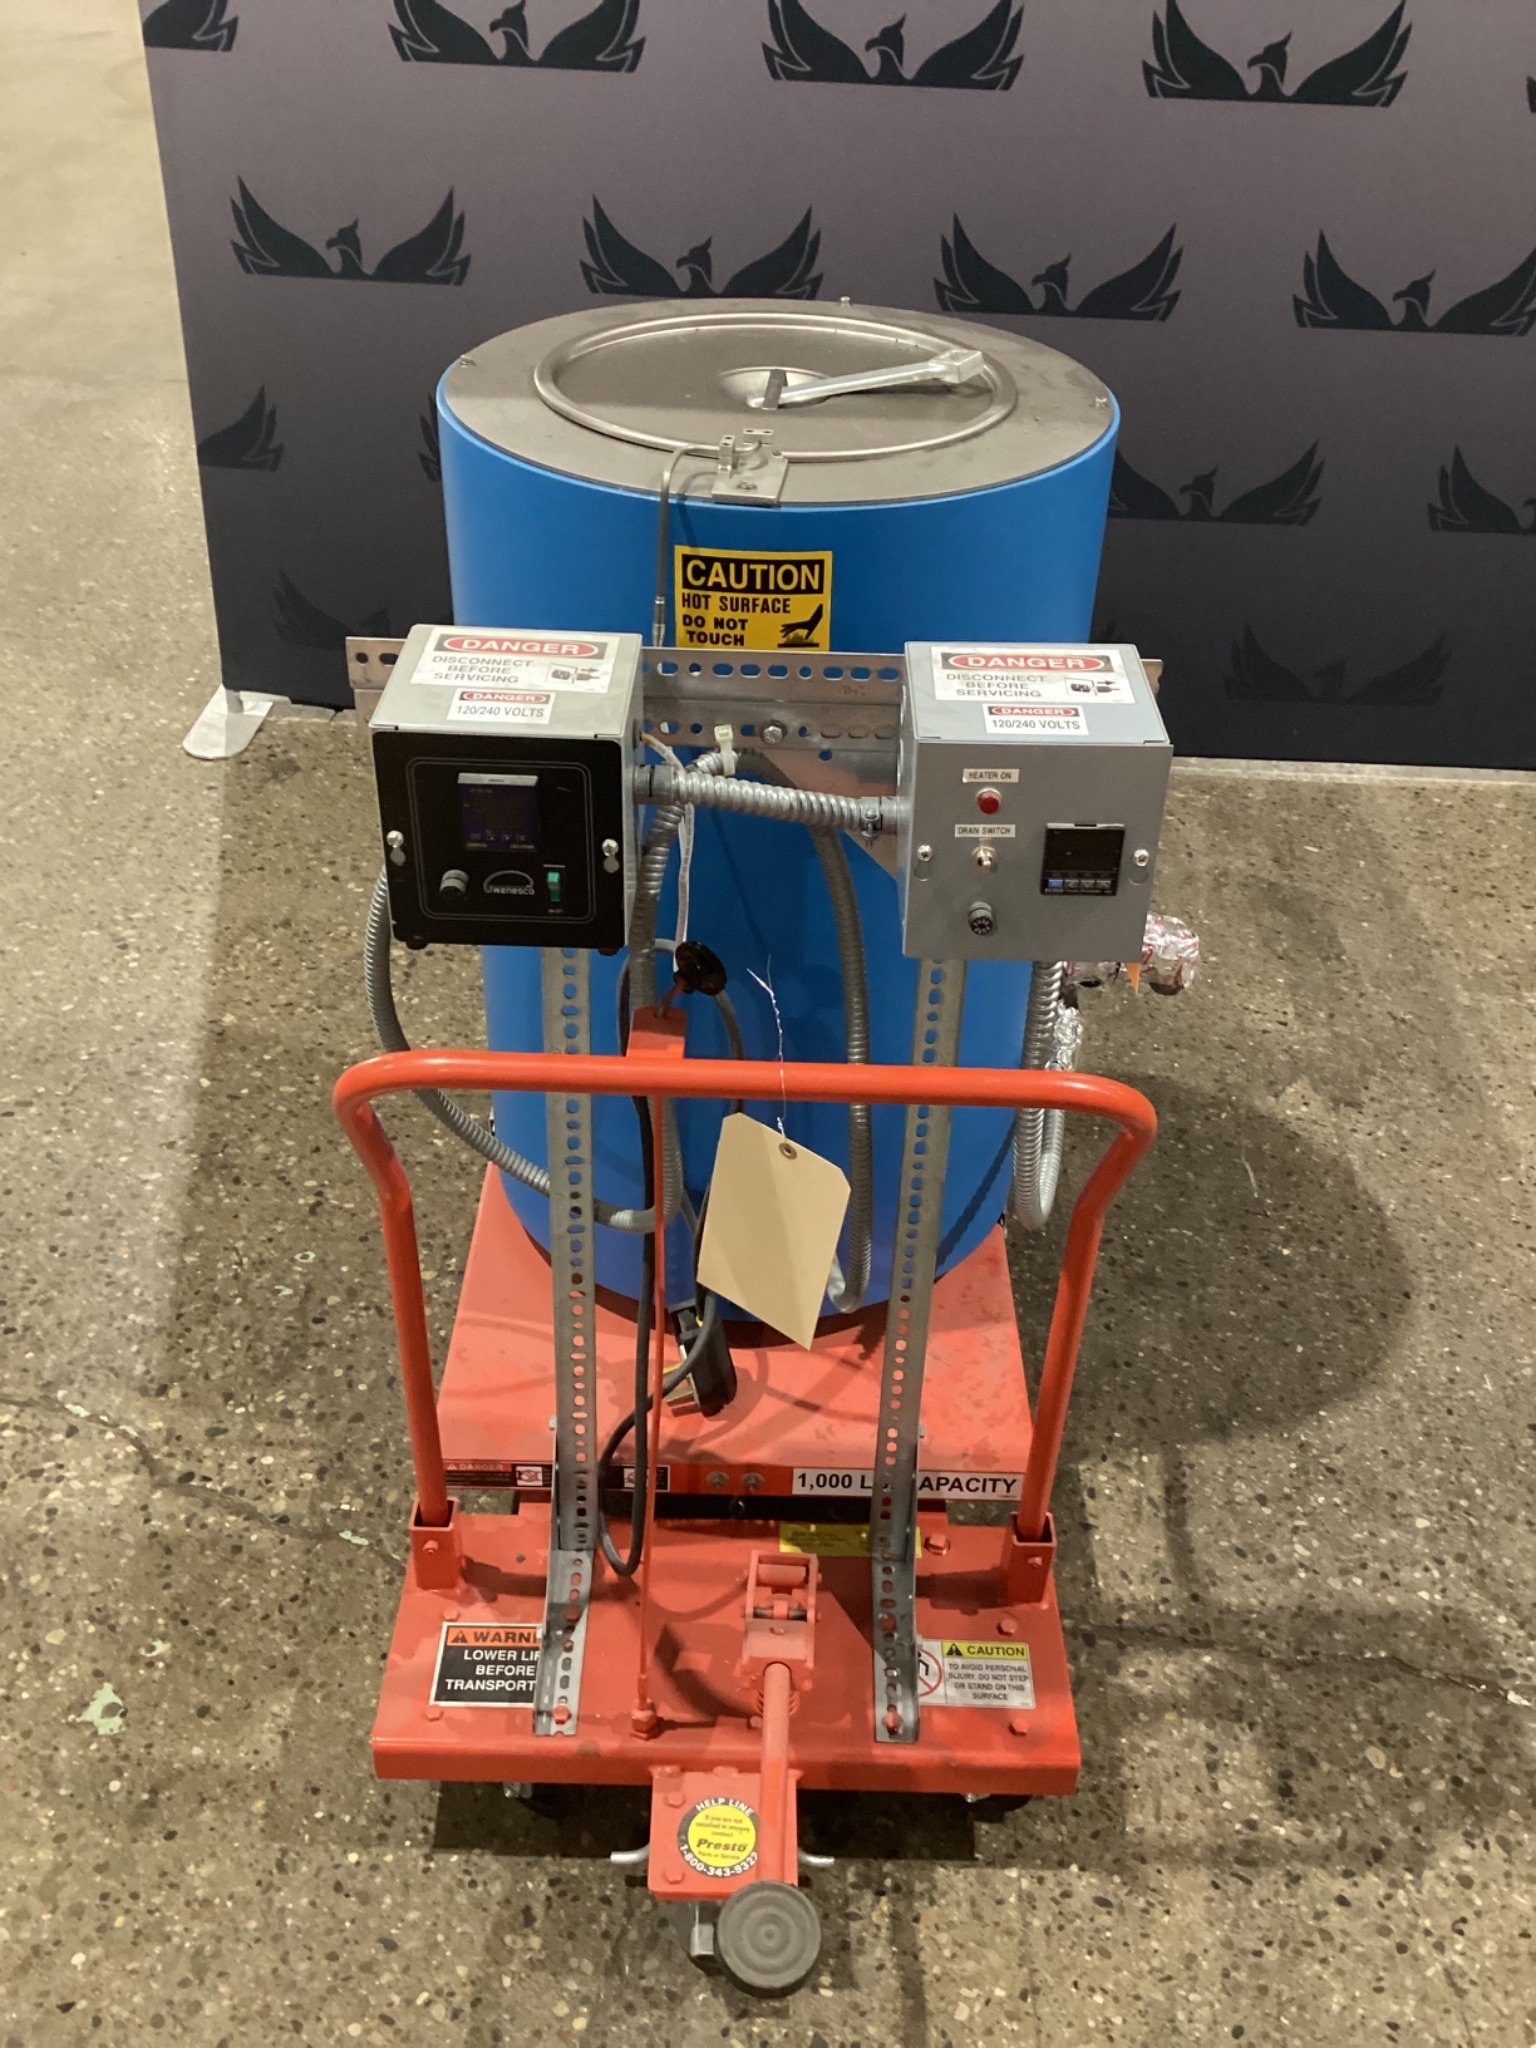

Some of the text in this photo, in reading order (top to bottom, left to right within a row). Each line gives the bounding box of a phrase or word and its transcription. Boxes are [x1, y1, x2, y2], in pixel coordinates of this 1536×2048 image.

[686, 559, 820, 591] CAUTION
[682, 593, 791, 614] HOT SURFACE
[682, 614, 748, 631] DO NOT
[686, 631, 745, 646] TOUCH
[461, 639, 580, 655] DANGER
[432, 656, 533, 667] DISCONNECT
[967, 656, 1086, 669] DANGER
[447, 665, 511, 675] BEFORE
[433, 672, 519, 684] SERVICING
[946, 673, 1046, 682] DISCONNECT
[965, 681, 1030, 690] BEFORE
[472, 693, 542, 702] DANGER
[956, 689, 1042, 698] SERVICING
[457, 705, 545, 718] 120/240 VOLTS
[1001, 707, 1065, 715] DANGER
[992, 719, 1081, 730] 120/240 VOLTS
[968, 771, 1012, 780] HEATER ON
[958, 827, 1011, 835] DRAIN SWITCH
[459, 1463, 504, 1472] DANGER
[797, 1472, 853, 1490] 1,000
[918, 1476, 1018, 1493] APACITY
[473, 1631, 537, 1644] WARNI
[463, 1650, 541, 1661] LOWER LIF
[966, 1645, 1025, 1657] CAUTION
[475, 1665, 535, 1676] BEFORE
[961, 1663, 983, 1671] AVOID
[985, 1664, 1027, 1673] PERSONAL
[978, 1673, 990, 1681] DO
[1009, 1674, 1029, 1682] STEP
[445, 1679, 537, 1691] TRANSPORT
[954, 1682, 1025, 1692] OR STAND ON THIS
[972, 1692, 1008, 1700] SURFACE
[695, 1797, 754, 1817] HELP LINE
[696, 1838, 748, 1852] Presto
[680, 1844, 758, 1877] 1-800-343-9327
